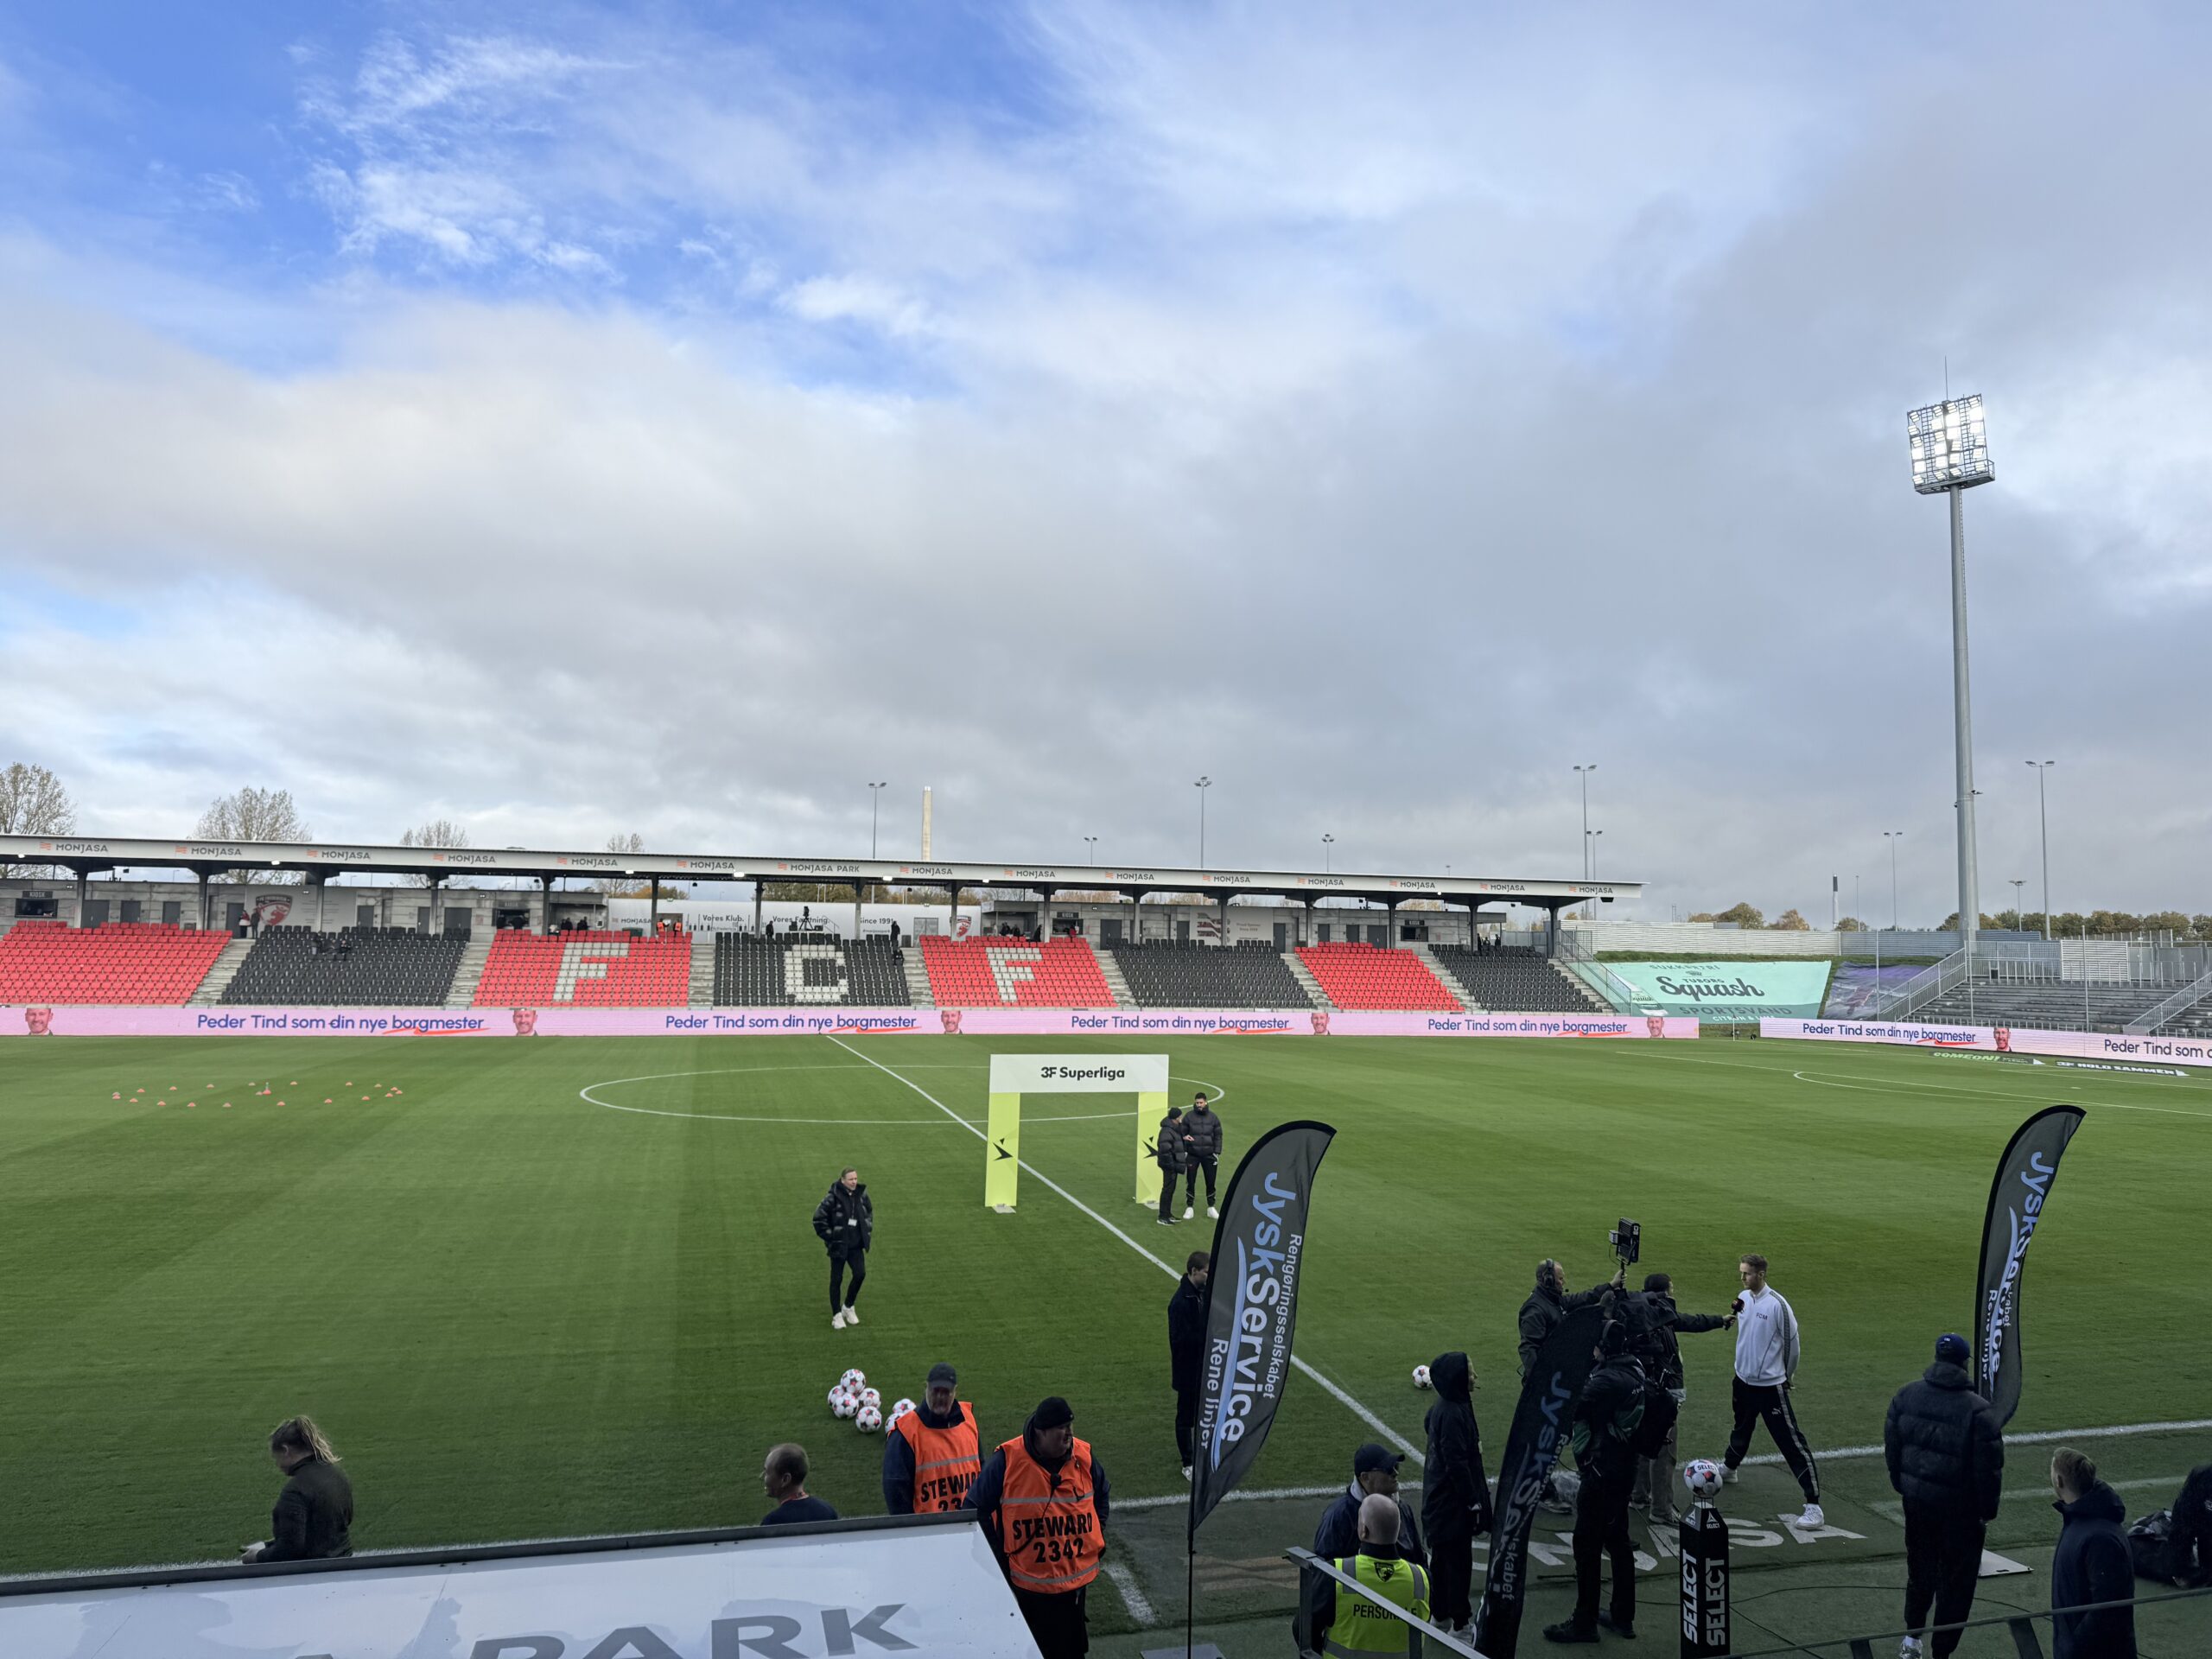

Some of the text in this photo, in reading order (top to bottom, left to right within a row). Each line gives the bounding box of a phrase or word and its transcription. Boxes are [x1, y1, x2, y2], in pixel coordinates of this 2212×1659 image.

[55, 843, 109, 853] MONJASA
[190, 847, 242, 856] MONJASA
[321, 850, 371, 860] MONJASA
[448, 854, 496, 863] MONJASA
[571, 858, 618, 868] MONJASA
[690, 861, 734, 870] MONJASA
[791, 863, 833, 873] MONJASA
[912, 867, 952, 876] MONJASA
[1016, 869, 1056, 879] MONJASA
[1116, 873, 1154, 882] MONJASA
[1213, 875, 1250, 885] MONJASA
[1308, 878, 1344, 887] MONJASA
[1400, 881, 1435, 891] MONJASA
[1491, 884, 1525, 893] MONJASA
[1579, 886, 1613, 895] MONJASA
[1656, 976, 1765, 1001] Squash
[1679, 1007, 1793, 1016] SPORTSVAND
[197, 1014, 484, 1033] Peder Tind som din nye borgmester
[665, 1015, 917, 1033] Peder Tind som din nye borgmester
[1071, 1015, 1289, 1032] Peder Tind som din nye borgmester
[1428, 1019, 1627, 1035] Peder Tind som din nye borgmester
[1802, 1023, 1976, 1043] Peder Tind som din nye borgmester
[2104, 1039, 2140, 1053] Peder
[2143, 1041, 2171, 1055] Tind
[2175, 1045, 2203, 1058] som
[1040, 1066, 1125, 1081] 3F Superliga
[2116, 1065, 2176, 1075] SAMMEN
[1220, 1172, 1296, 1442] JyskService
[1263, 1233, 1303, 1399] Rengøringsselskabet
[1199, 1338, 1228, 1451] Rene linjer
[921, 1471, 981, 1503] STEWAR
[1013, 1512, 1093, 1541] STEWARD
[1033, 1538, 1084, 1564] 2342
[1682, 1548, 1698, 1645] SELECT
[1705, 1557, 1726, 1646] SELECT
